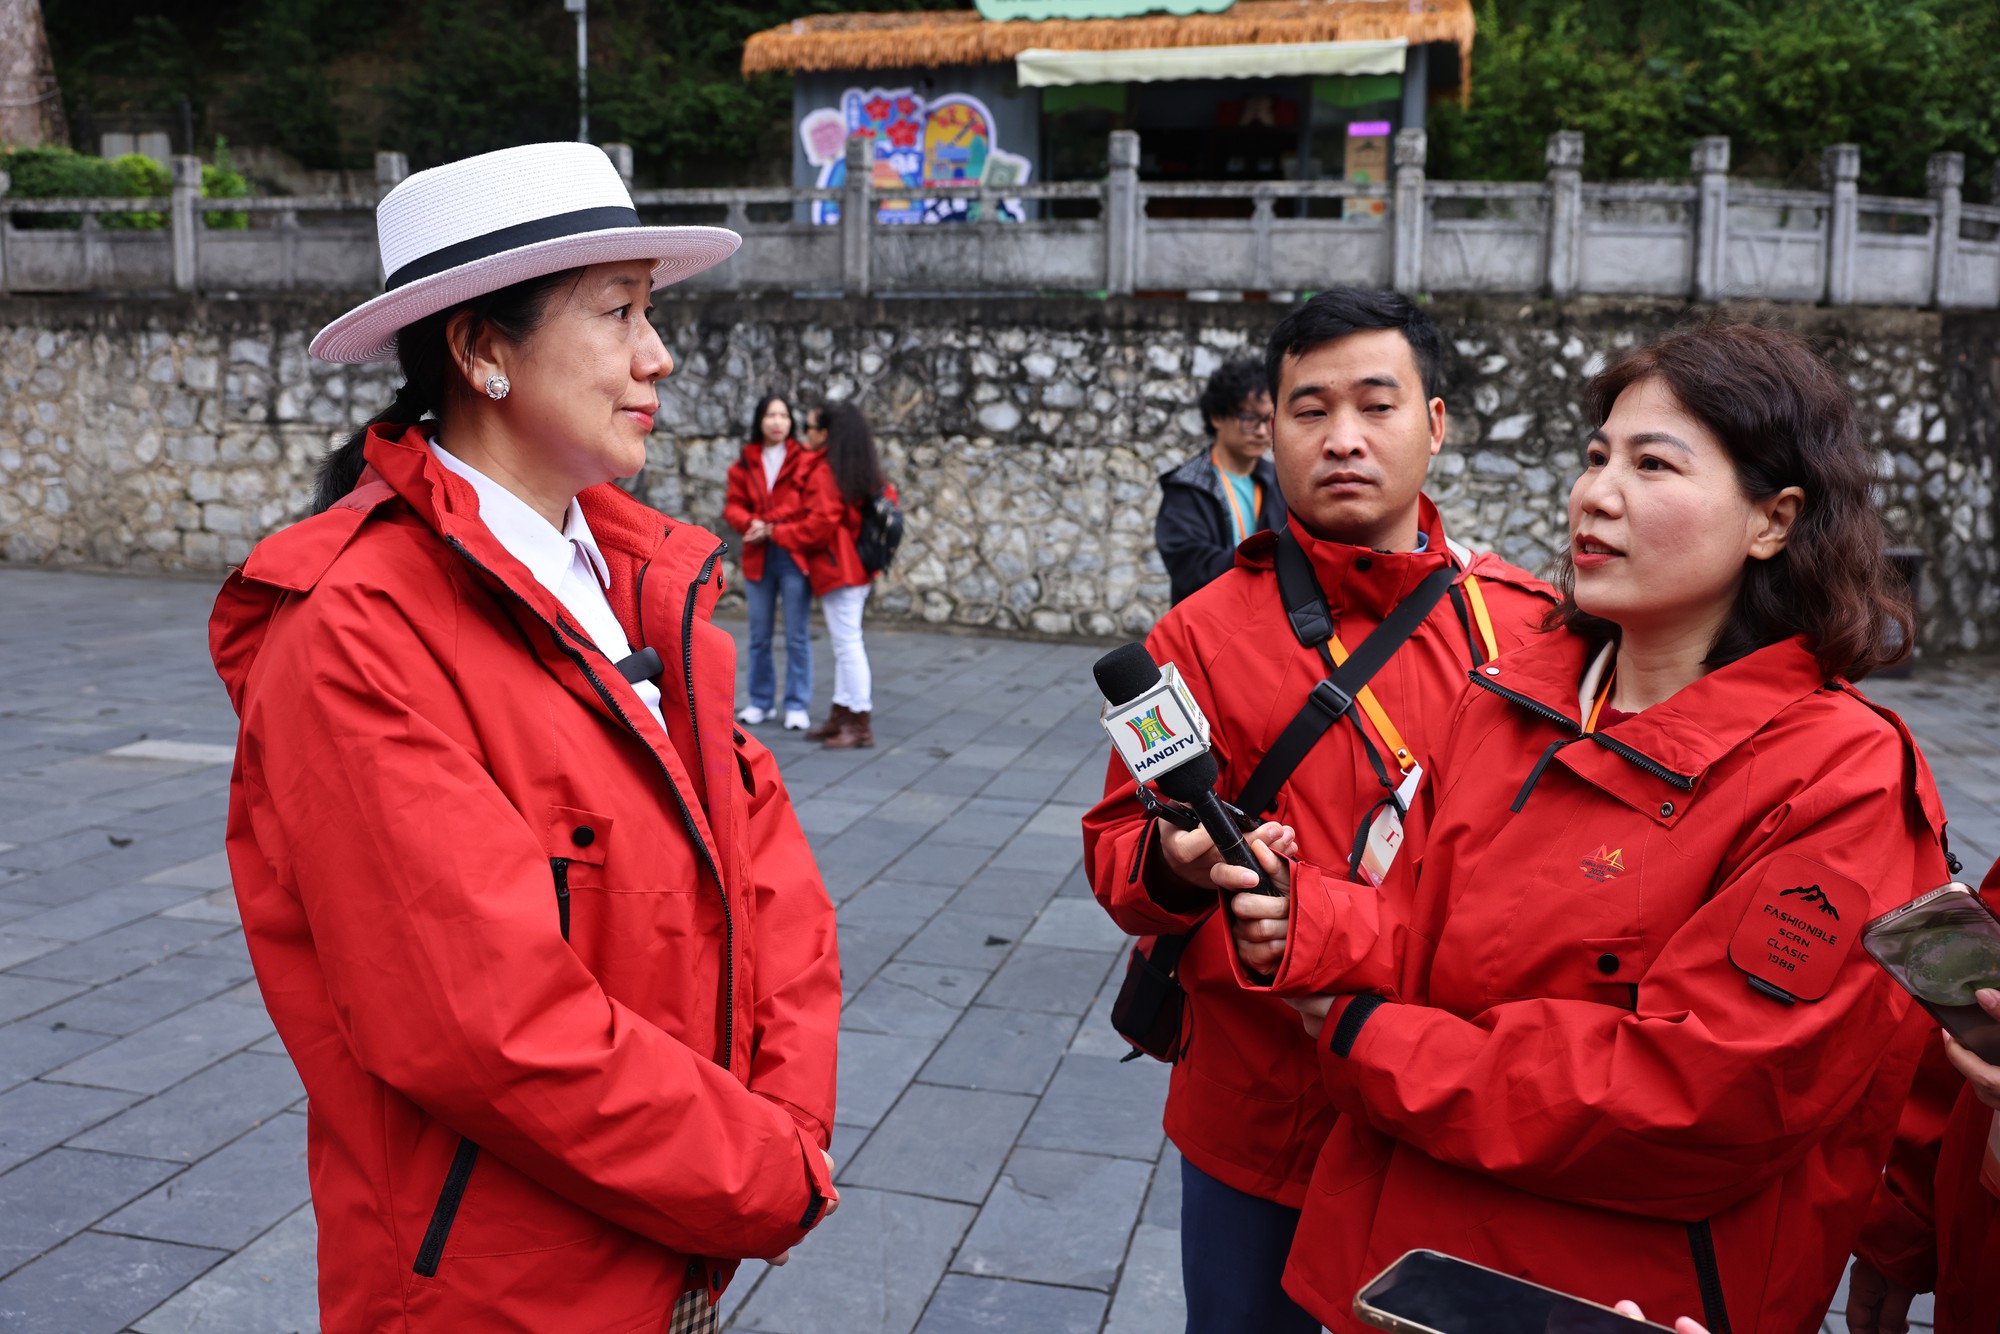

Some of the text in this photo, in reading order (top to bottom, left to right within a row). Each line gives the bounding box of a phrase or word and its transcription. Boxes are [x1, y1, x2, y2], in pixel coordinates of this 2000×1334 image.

[1134, 734, 1194, 772] HANOITV
[1589, 868, 1605, 877] 2025
[1778, 928, 1811, 948] SCRN
[1767, 937, 1809, 963] CLASIC
[1767, 953, 1796, 972] 1988
